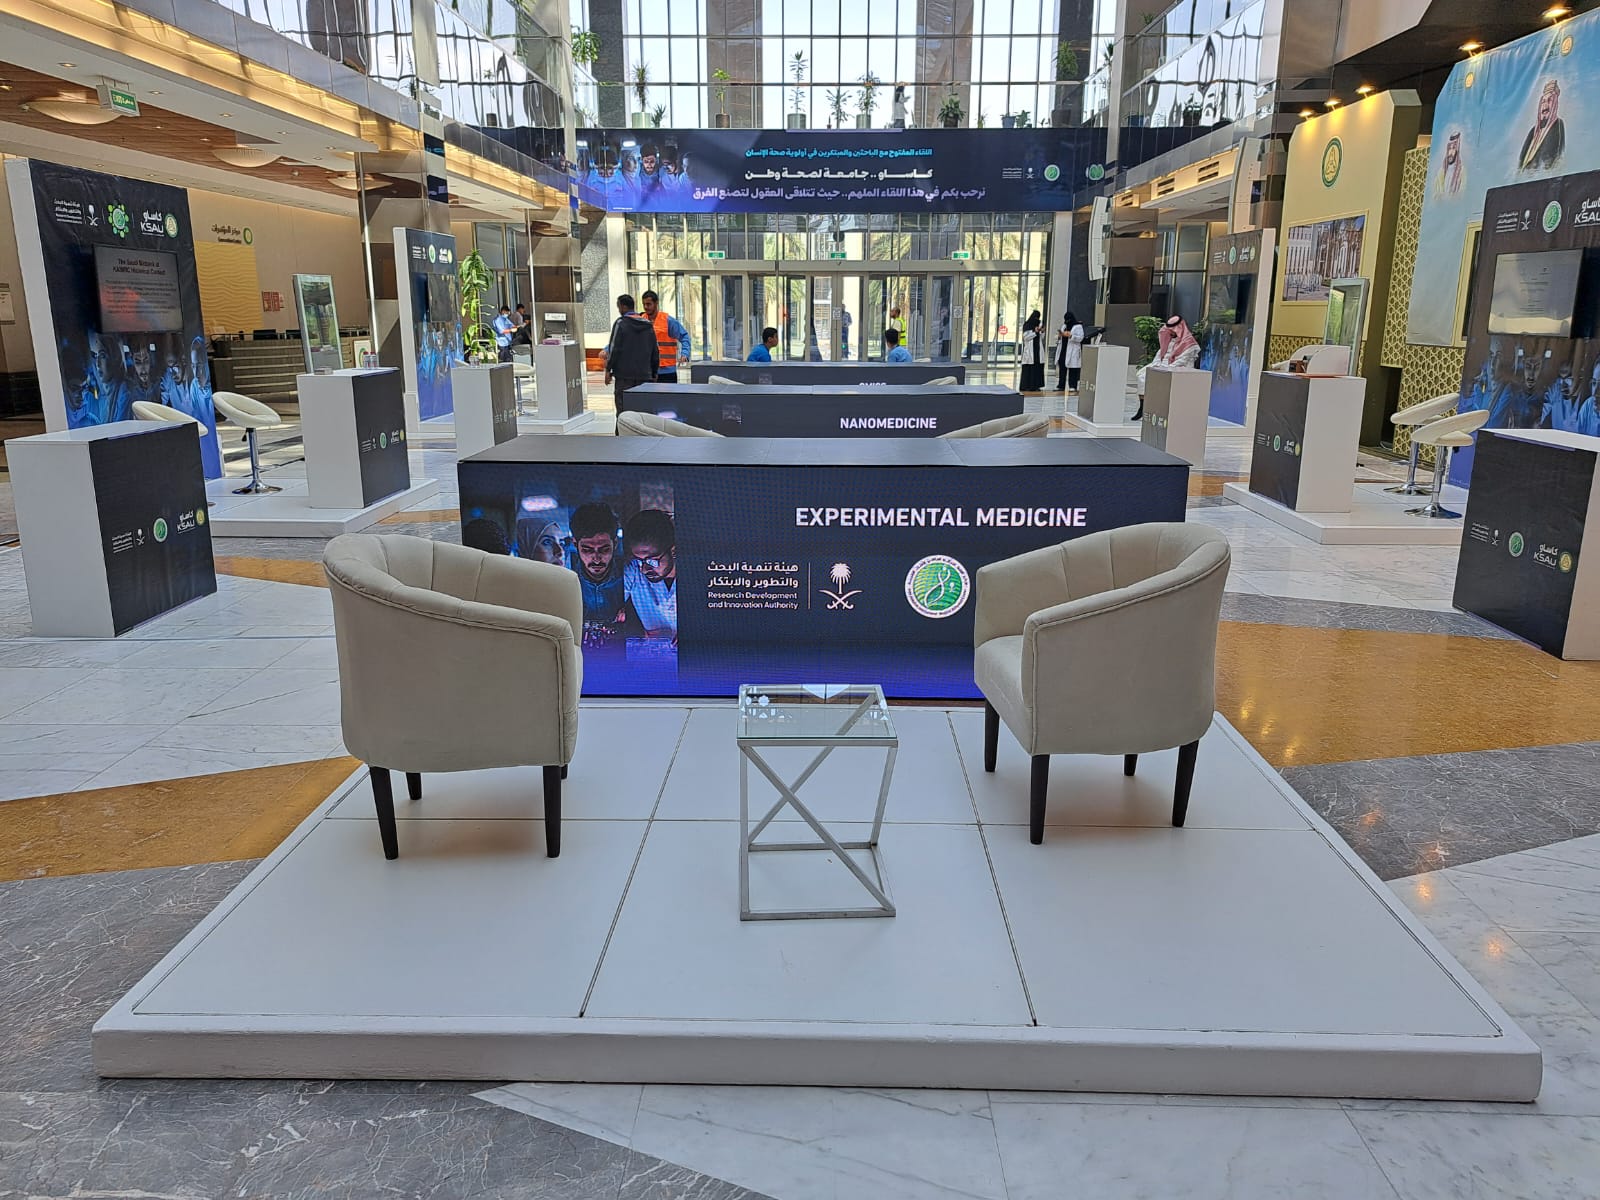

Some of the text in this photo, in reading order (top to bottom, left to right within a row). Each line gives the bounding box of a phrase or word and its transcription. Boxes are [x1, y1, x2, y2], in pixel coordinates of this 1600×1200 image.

[745, 149, 768, 158] الإنسان
[769, 148, 785, 156] صحة
[786, 148, 807, 157] أولوية
[807, 148, 817, 159] في
[818, 149, 852, 158] والمبتكرين
[853, 149, 878, 157] الباحثين
[889, 149, 915, 158] المفتوح
[745, 168, 781, 181] وطن
[782, 167, 822, 178] لصحة
[823, 167, 869, 181] جامعة
[693, 187, 718, 200] الفرق
[719, 187, 750, 200] لتصنع
[751, 187, 784, 200] العقول
[784, 186, 816, 200] تتلاقى
[817, 188, 840, 200] حيث
[880, 187, 906, 198] اللقاء
[907, 187, 925, 198] هذا
[925, 186, 940, 202] في
[941, 187, 959, 200] بكم
[960, 187, 986, 199] نرحب
[1581, 197, 1600, 212] اساو
[840, 417, 937, 429] NANOMEDICINE
[795, 507, 1088, 527] EXPERIMENTAL MEDICINE
[707, 561, 740, 572] البحث
[741, 562, 773, 573] تنمية
[708, 576, 799, 588] والتطوير والابتكار
[708, 591, 797, 600] Research Development
[764, 601, 798, 609] Authority
